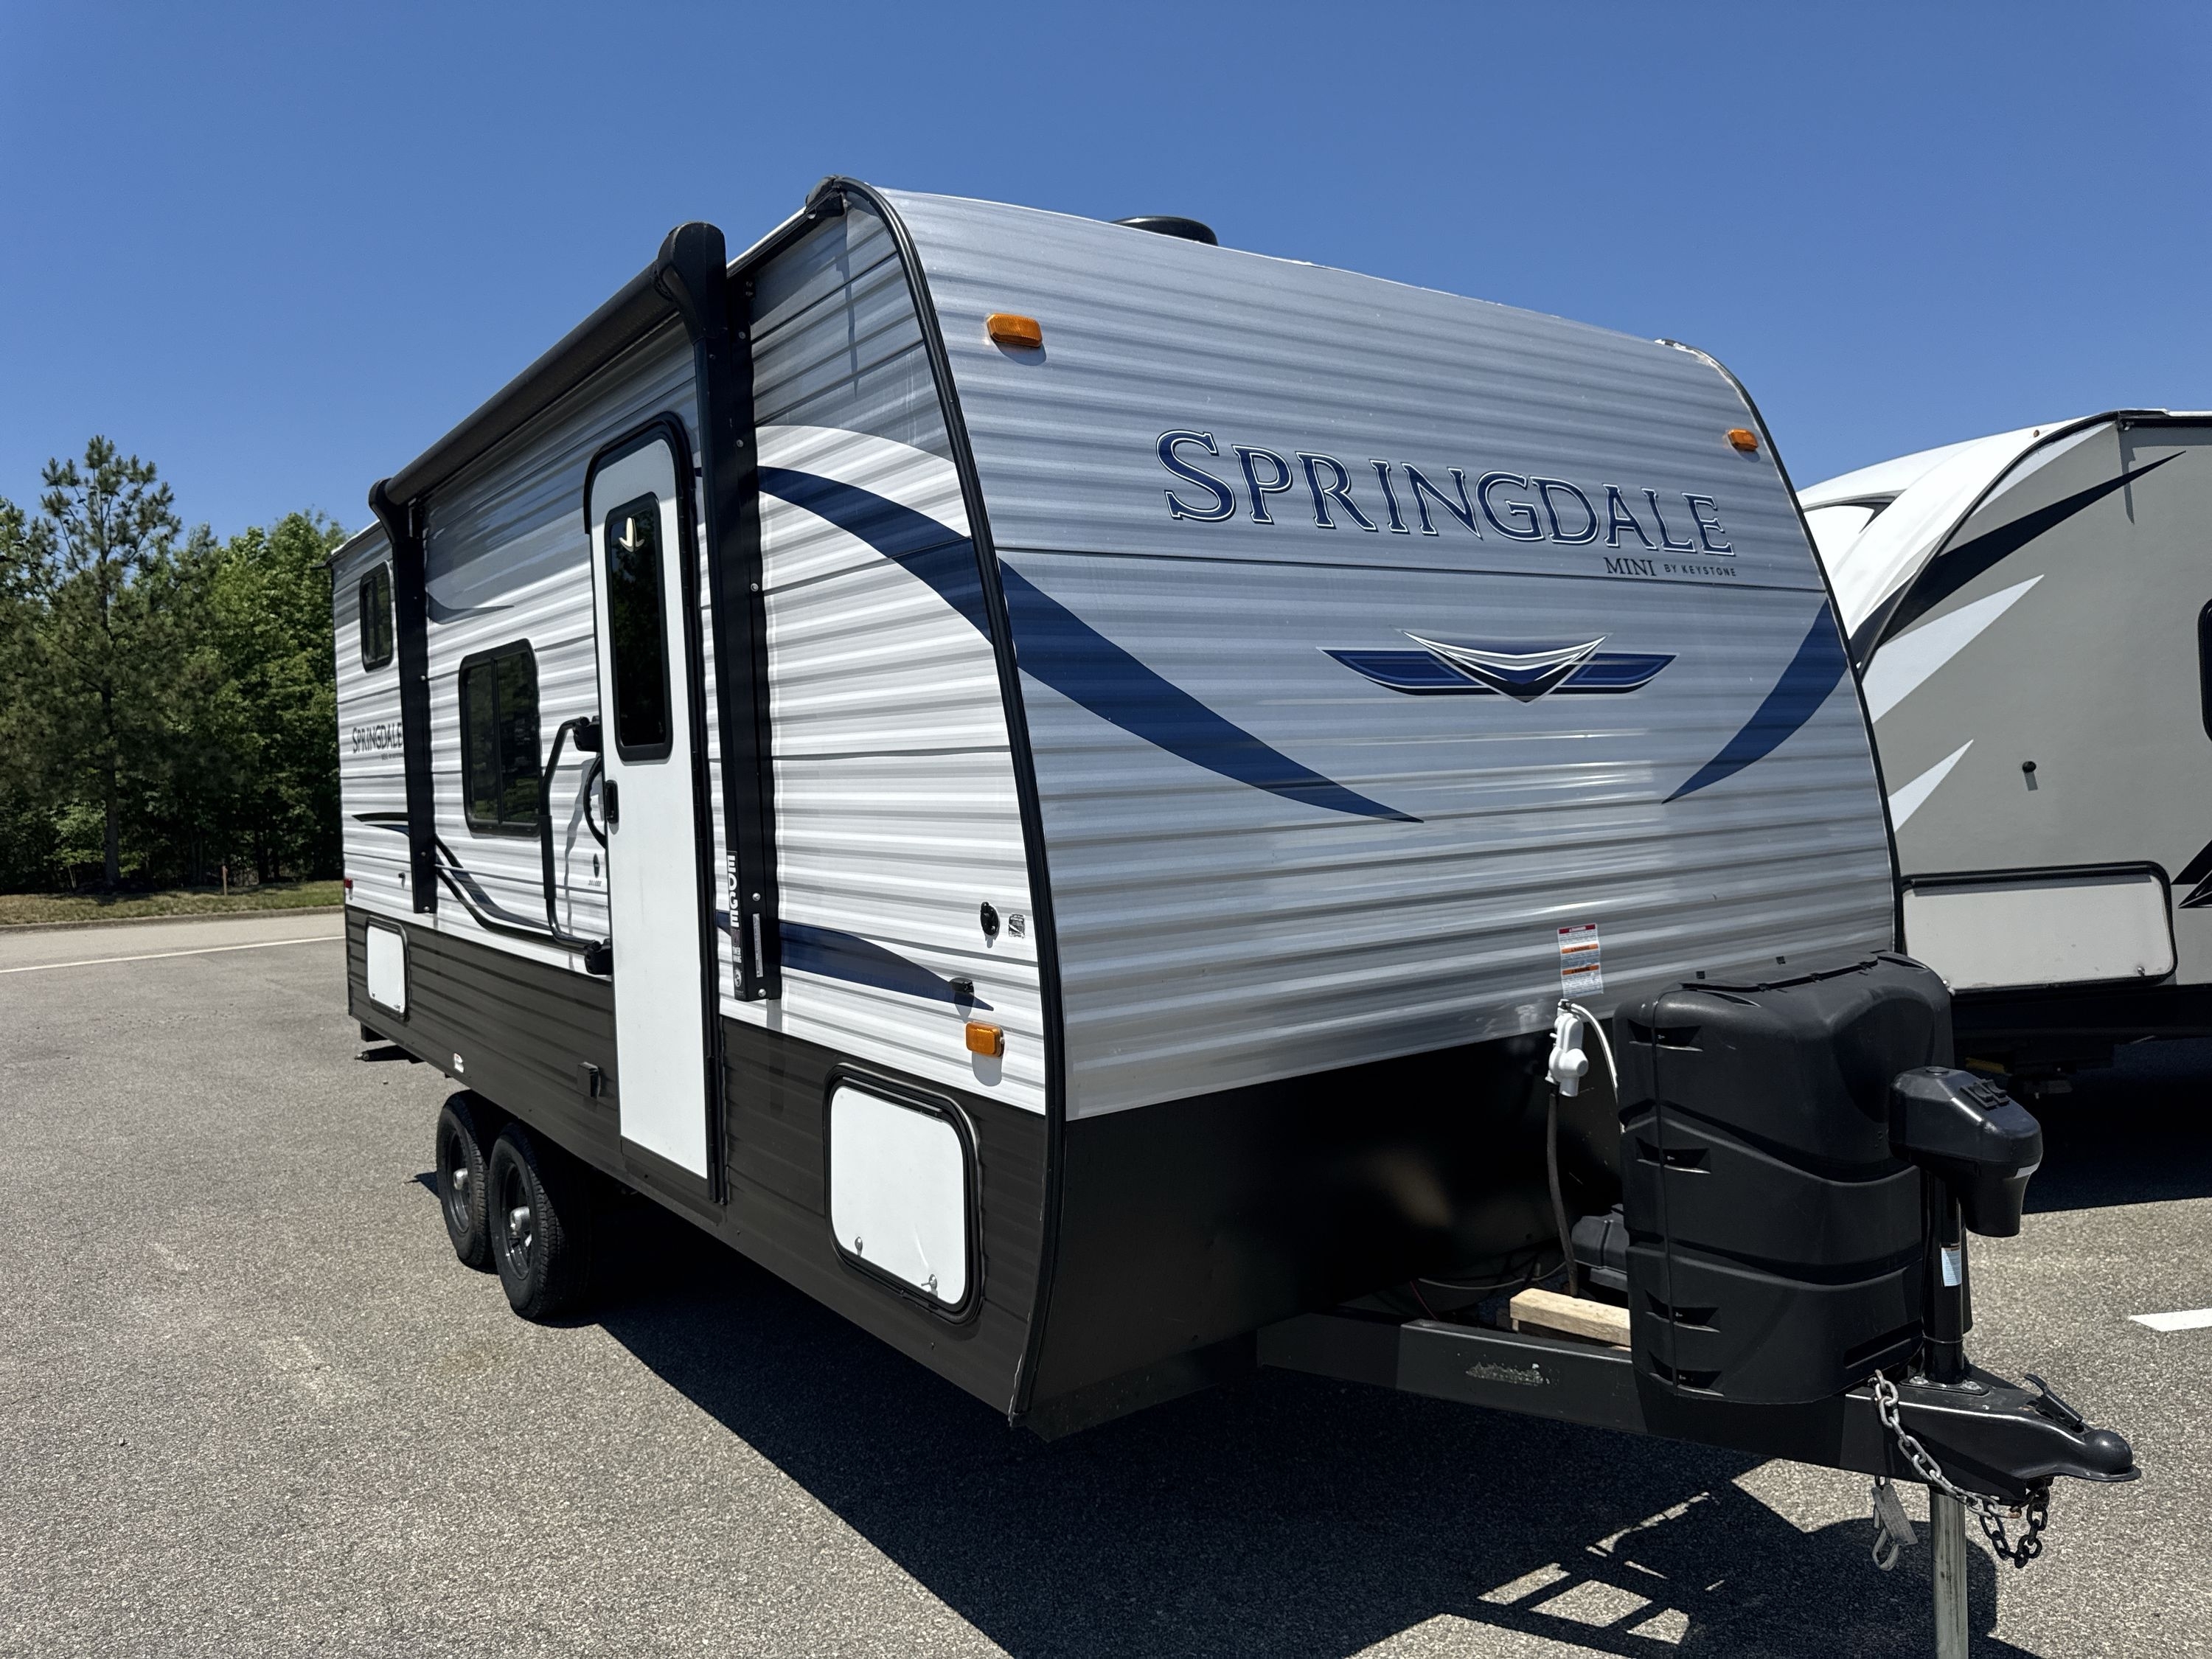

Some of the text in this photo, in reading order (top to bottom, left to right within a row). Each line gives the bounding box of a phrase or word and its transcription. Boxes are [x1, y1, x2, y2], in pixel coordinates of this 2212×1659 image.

[1156, 429, 1736, 557] SPRINGDALE
[1603, 557, 1736, 577] MINI BY KEYSTONE
[352, 722, 403, 754] SPRINGDALE
[726, 855, 740, 928] EDGE
